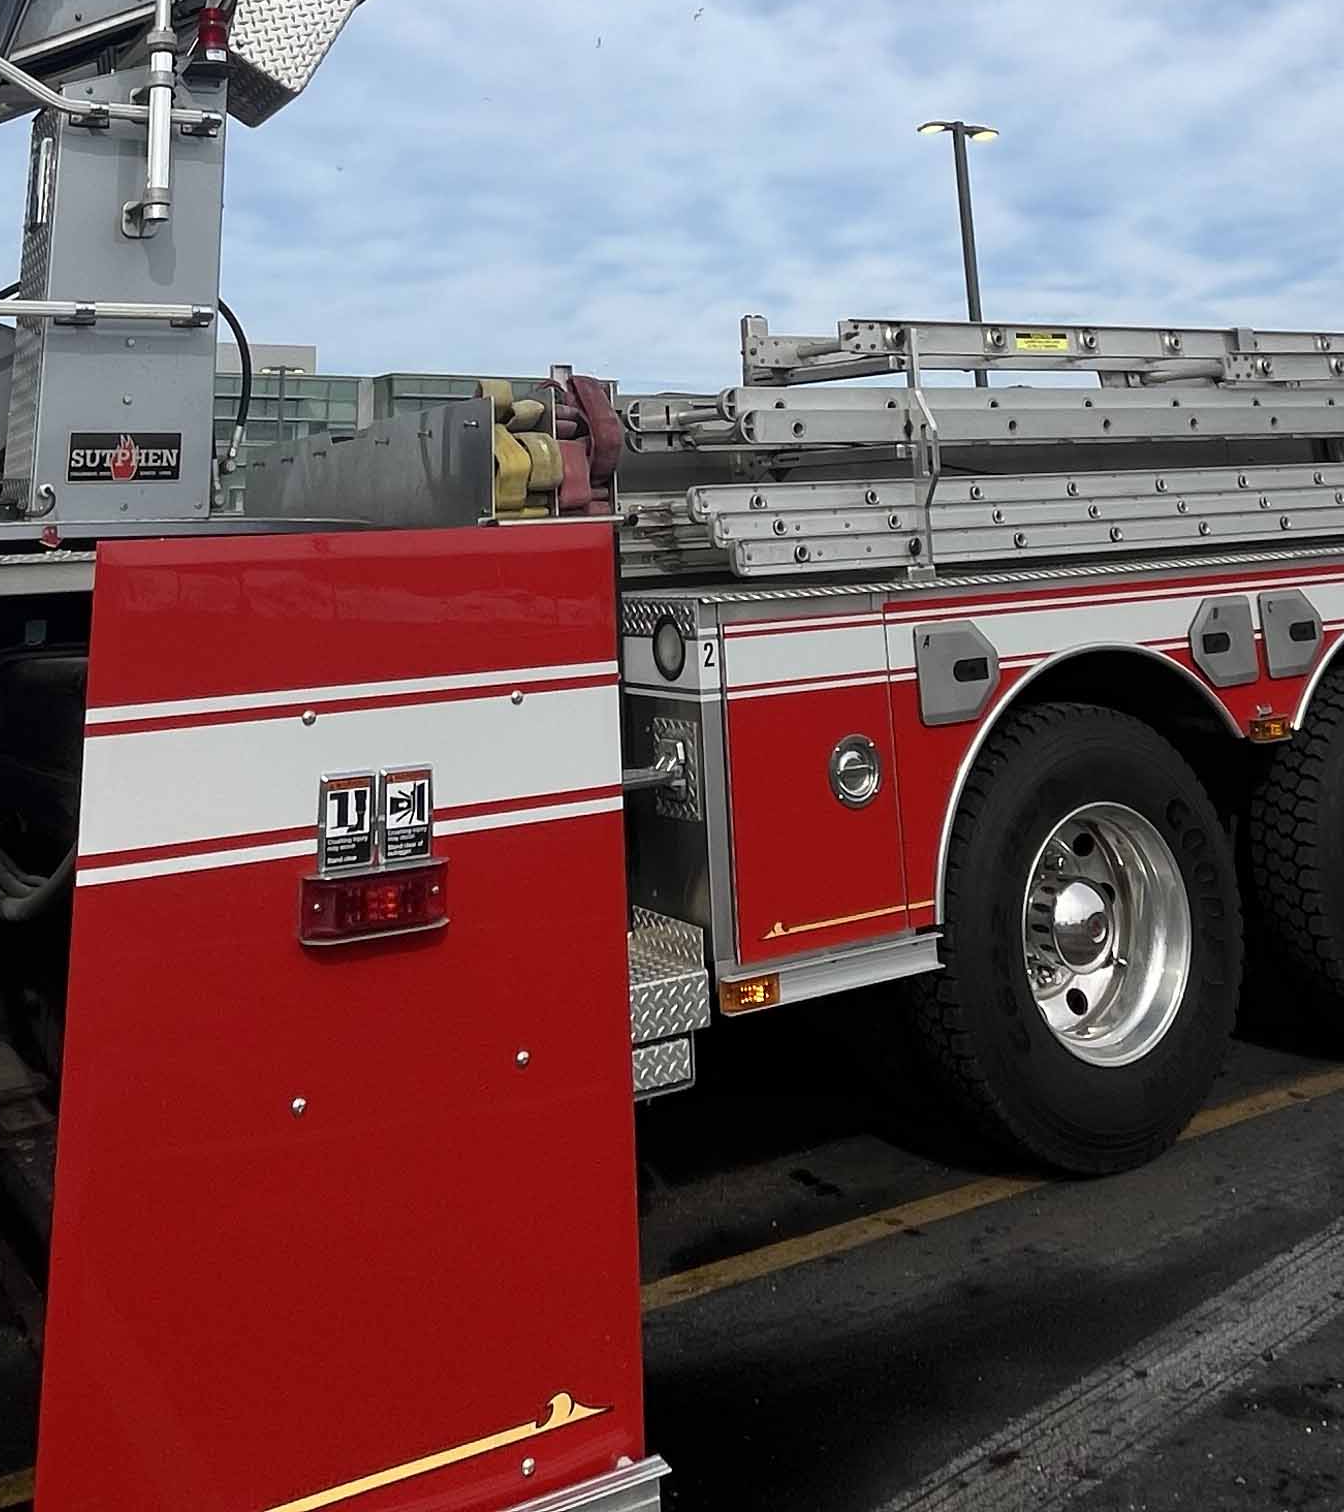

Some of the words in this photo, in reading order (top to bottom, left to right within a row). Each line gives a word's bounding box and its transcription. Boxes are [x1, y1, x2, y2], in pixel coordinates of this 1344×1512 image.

[71, 448, 178, 467] SUTPHEN
[922, 634, 930, 648] A
[703, 642, 715, 667] 2
